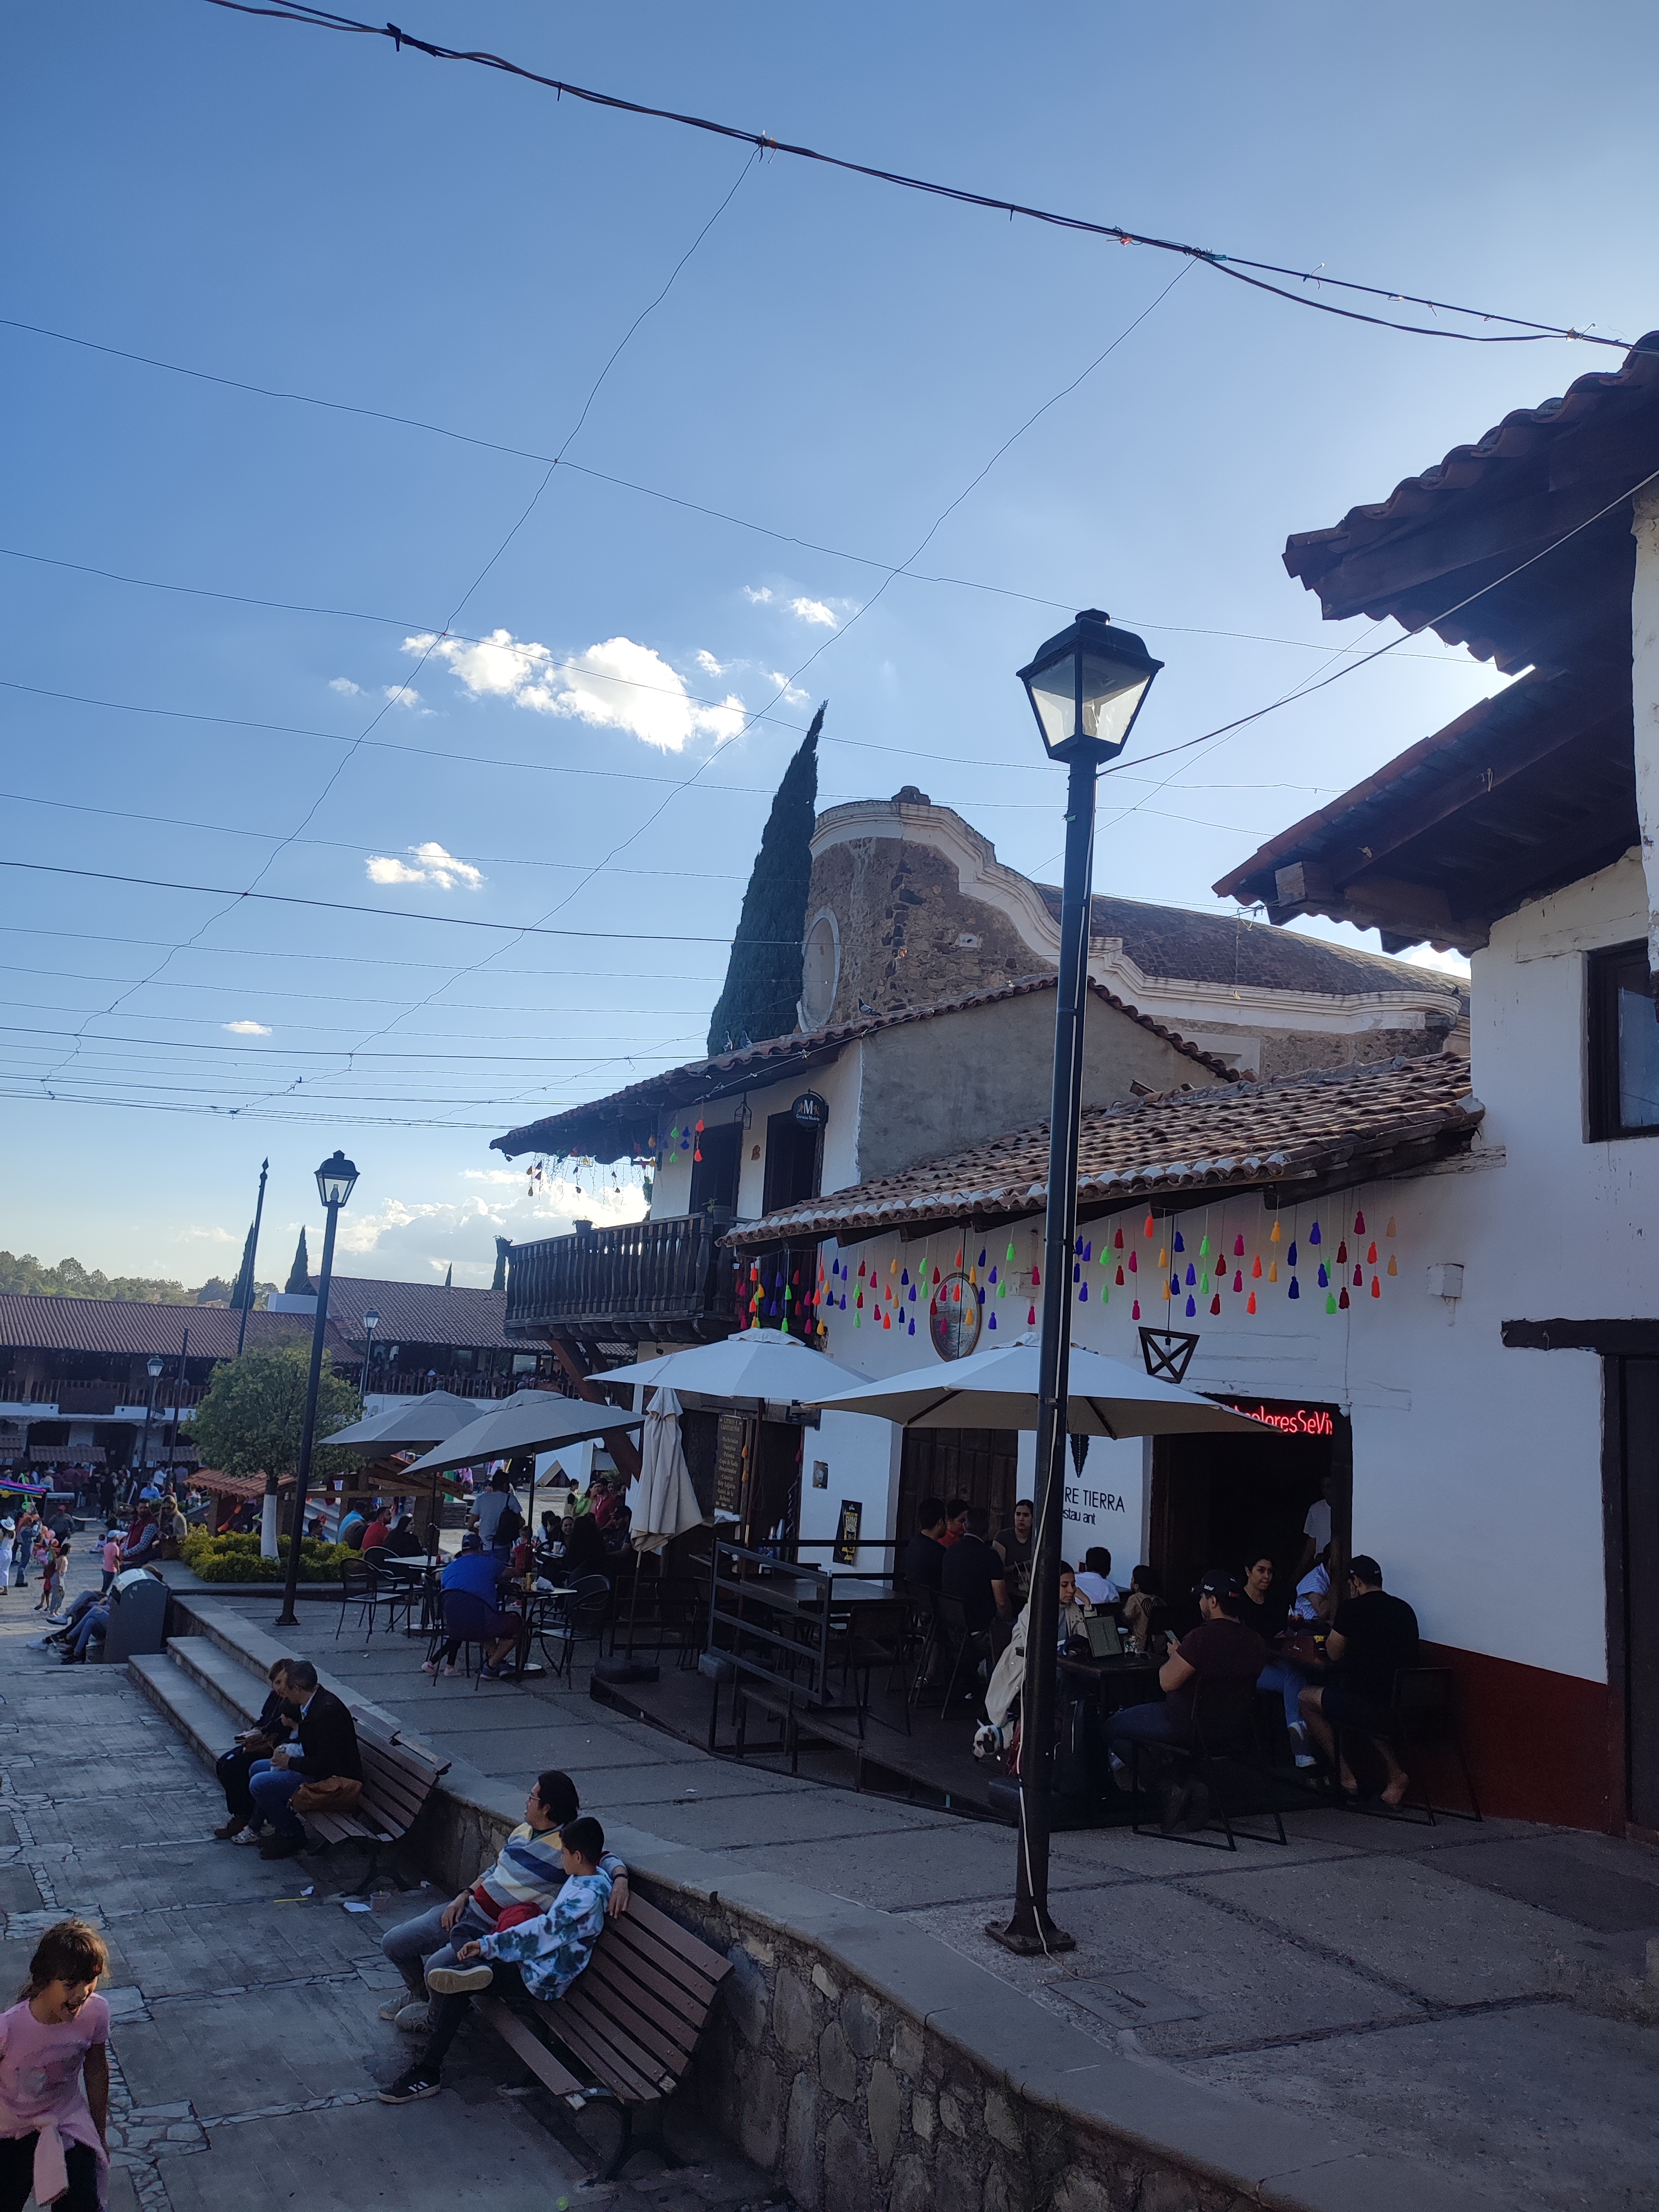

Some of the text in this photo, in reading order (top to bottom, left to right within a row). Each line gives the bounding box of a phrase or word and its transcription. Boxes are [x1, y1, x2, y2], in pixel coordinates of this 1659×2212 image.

[804, 1099, 813, 1115] M
[1065, 1486, 1125, 1512] RE TIERRA
